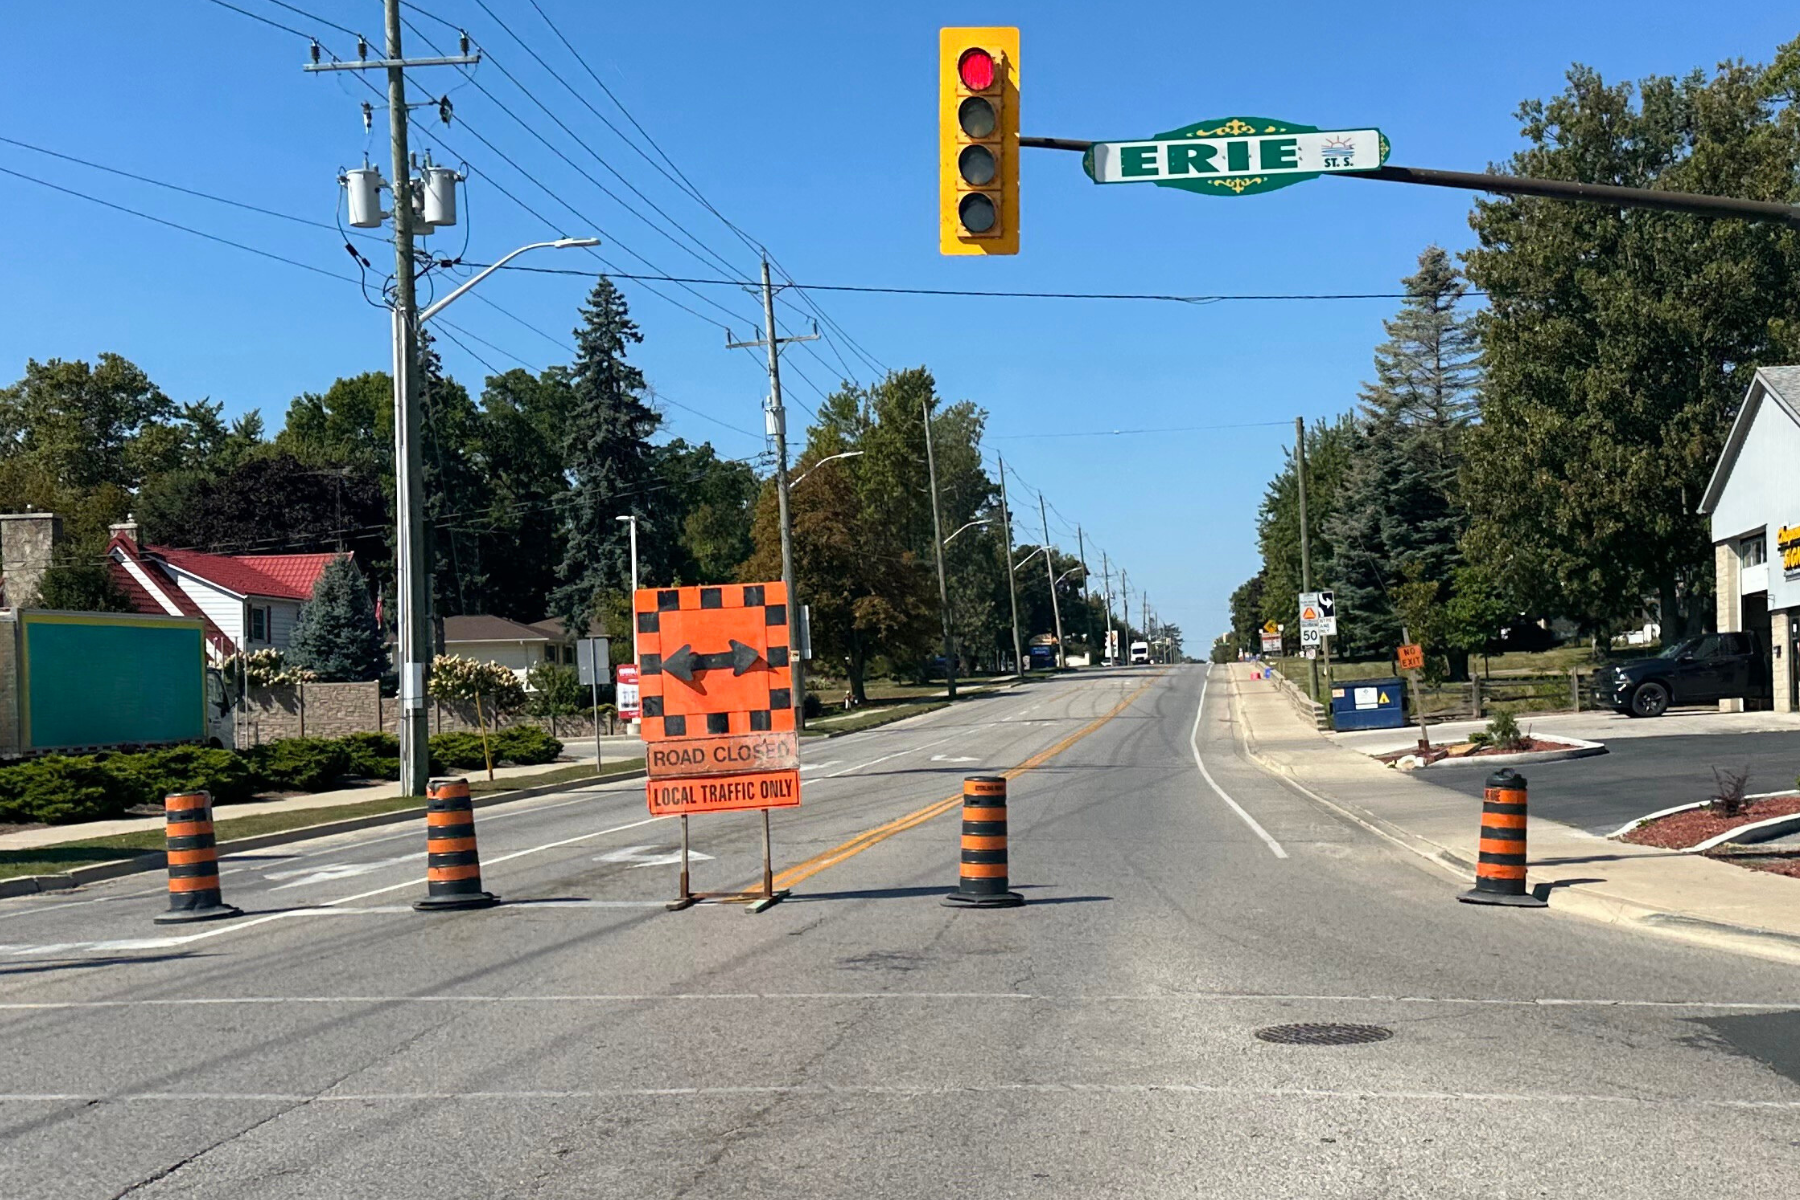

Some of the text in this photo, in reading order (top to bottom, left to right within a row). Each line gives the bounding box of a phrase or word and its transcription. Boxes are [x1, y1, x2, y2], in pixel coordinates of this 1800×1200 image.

[1120, 138, 1354, 177] ERIE ST. S.
[1303, 630, 1318, 641] 50
[1403, 647, 1416, 656] NO
[1401, 656, 1421, 667] EXIT
[654, 740, 790, 767] ROAD CLOSED
[654, 778, 793, 807] LOCAL TRAFFIC ONLY
